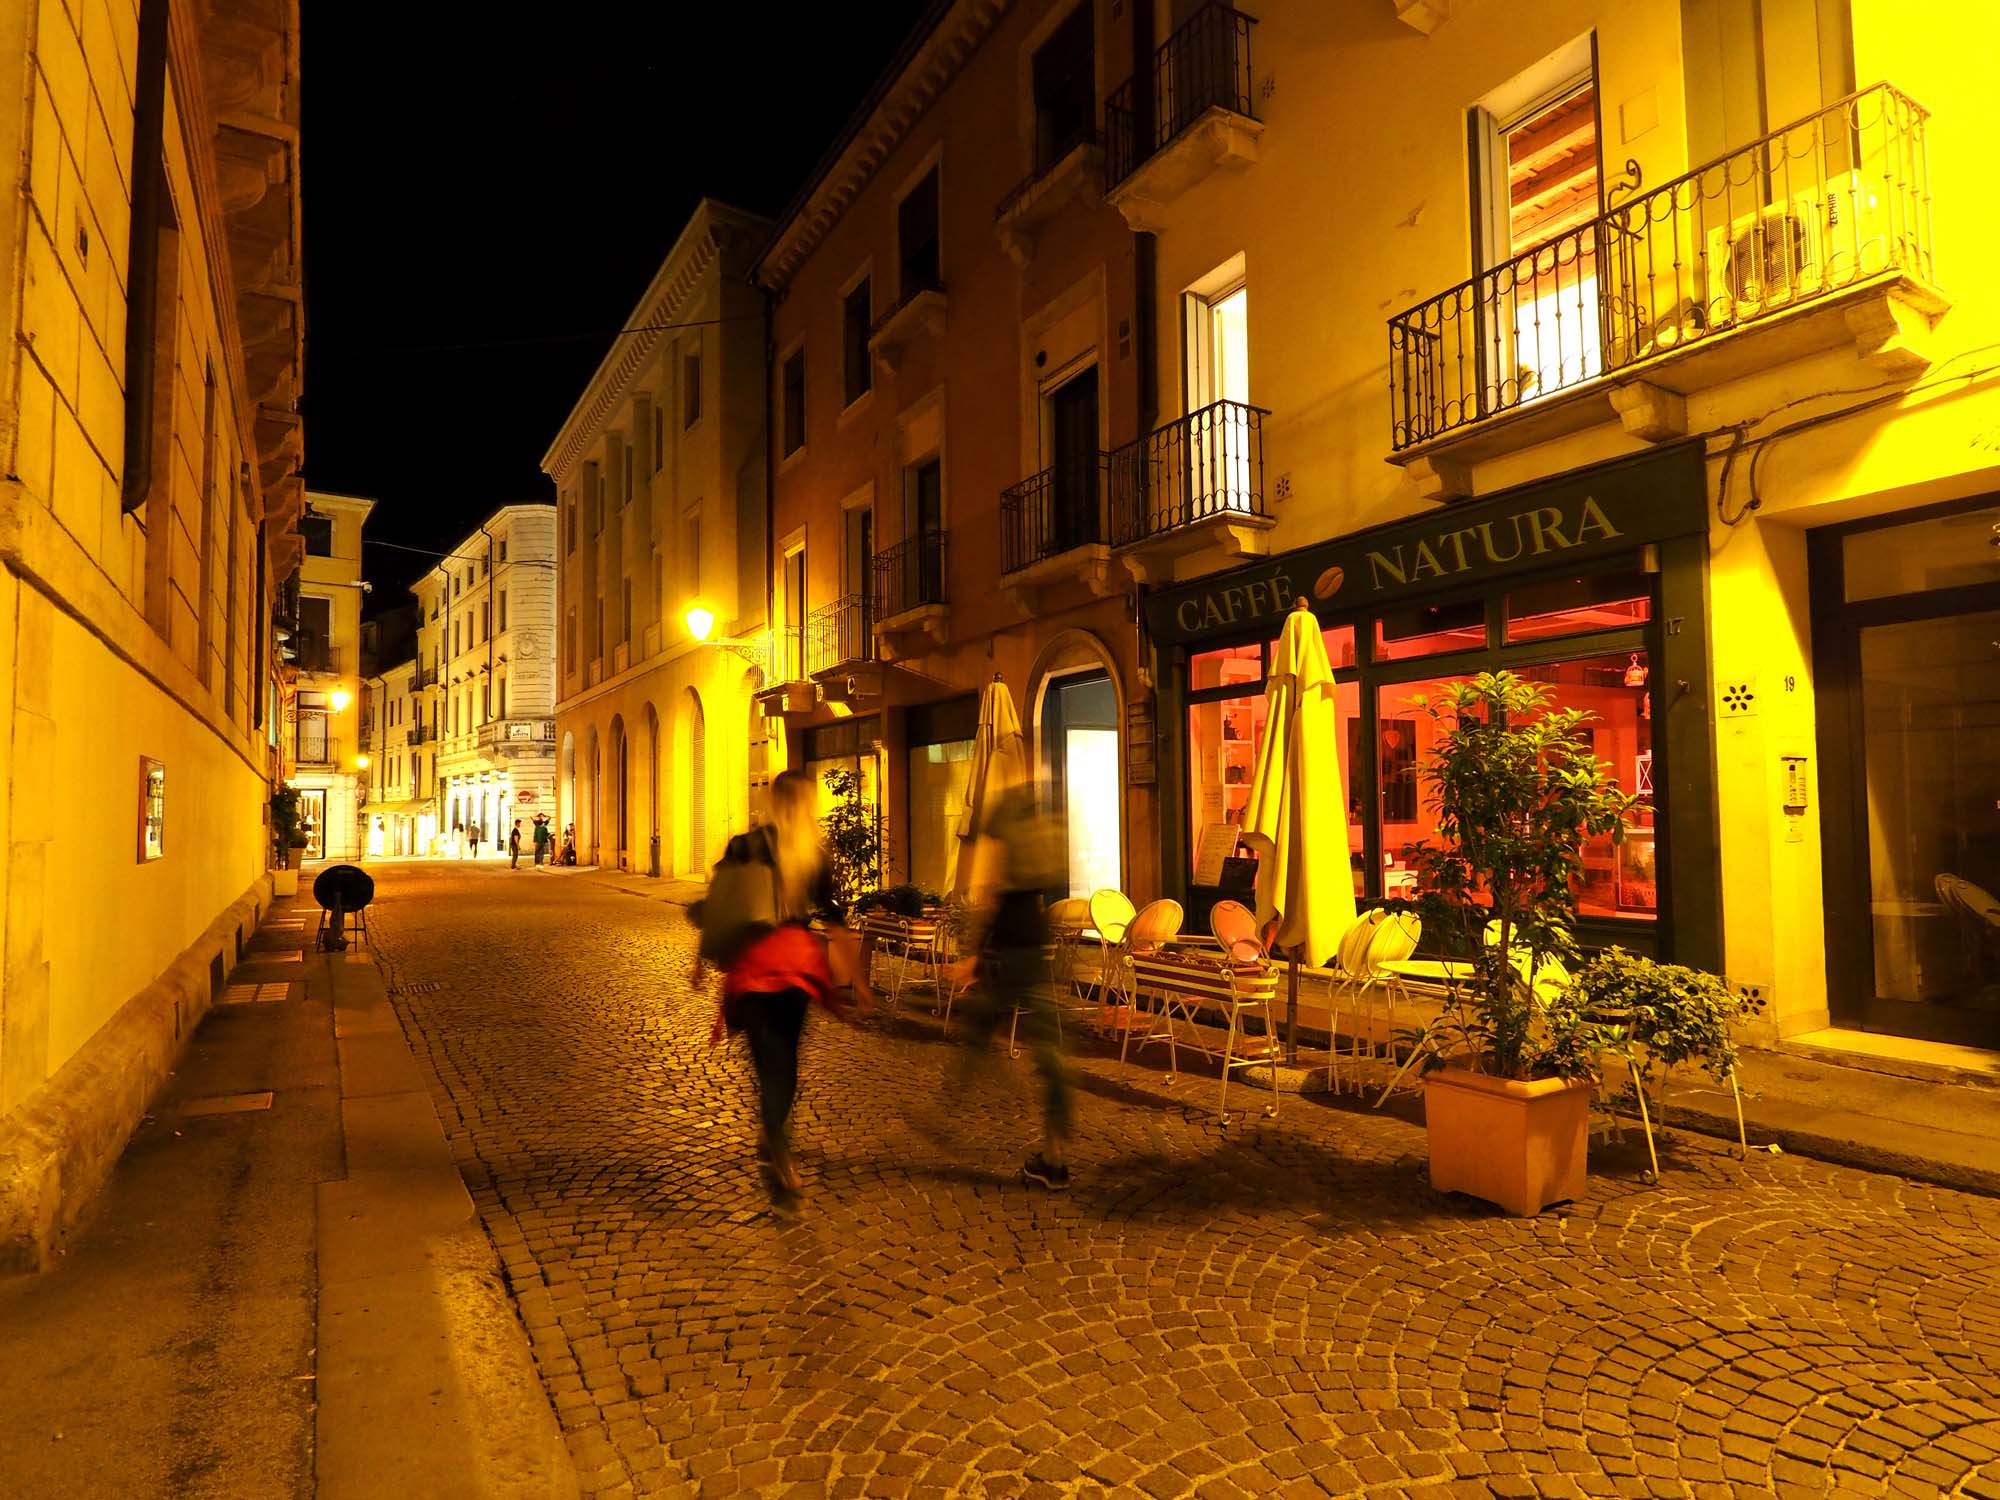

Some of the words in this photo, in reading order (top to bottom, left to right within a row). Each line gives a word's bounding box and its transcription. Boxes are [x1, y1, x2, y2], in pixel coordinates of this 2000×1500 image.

[1827, 193, 1838, 225] ZEPHIR
[1177, 566, 1297, 632] CAFFÉ
[1366, 495, 1625, 590] NATURA
[1666, 616, 1685, 636] 17
[1784, 675, 1795, 692] 19
